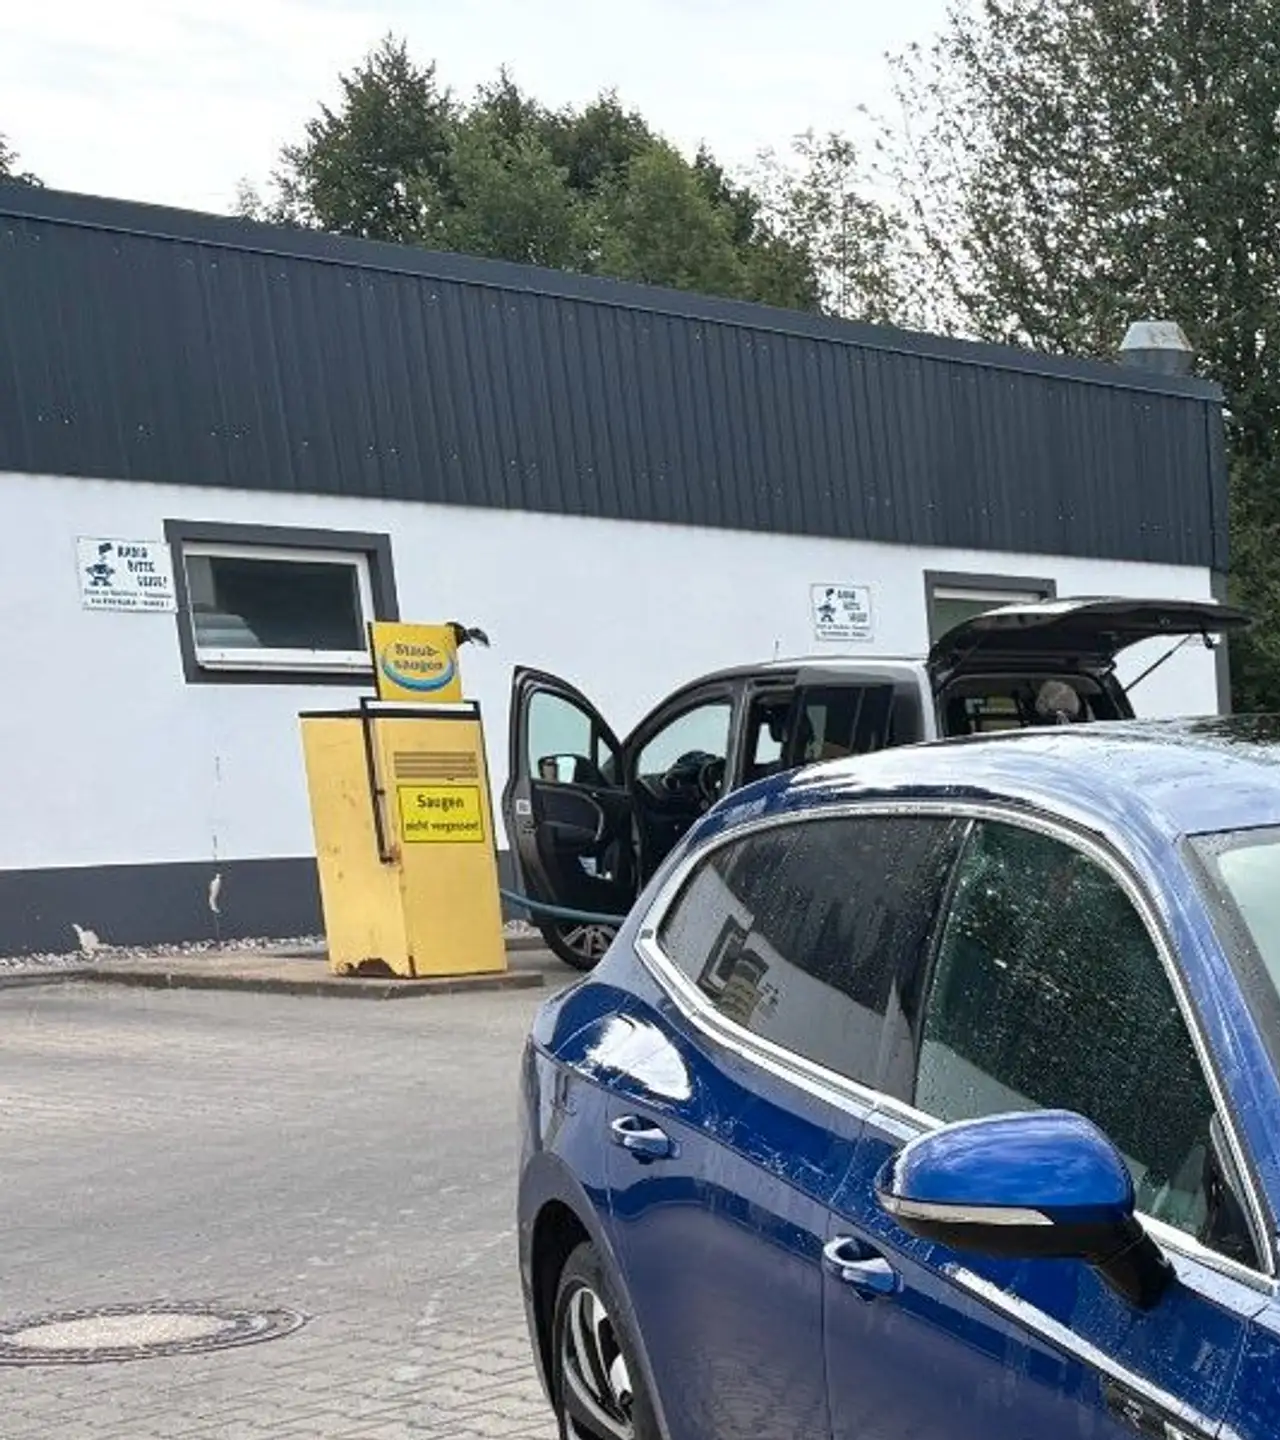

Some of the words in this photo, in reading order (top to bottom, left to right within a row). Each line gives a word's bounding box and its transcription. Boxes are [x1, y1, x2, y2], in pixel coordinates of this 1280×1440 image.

[395, 643, 441, 658] Staub-
[393, 658, 443, 672] saugen
[417, 794, 465, 813] Saugen
[405, 821, 429, 832] nicht
